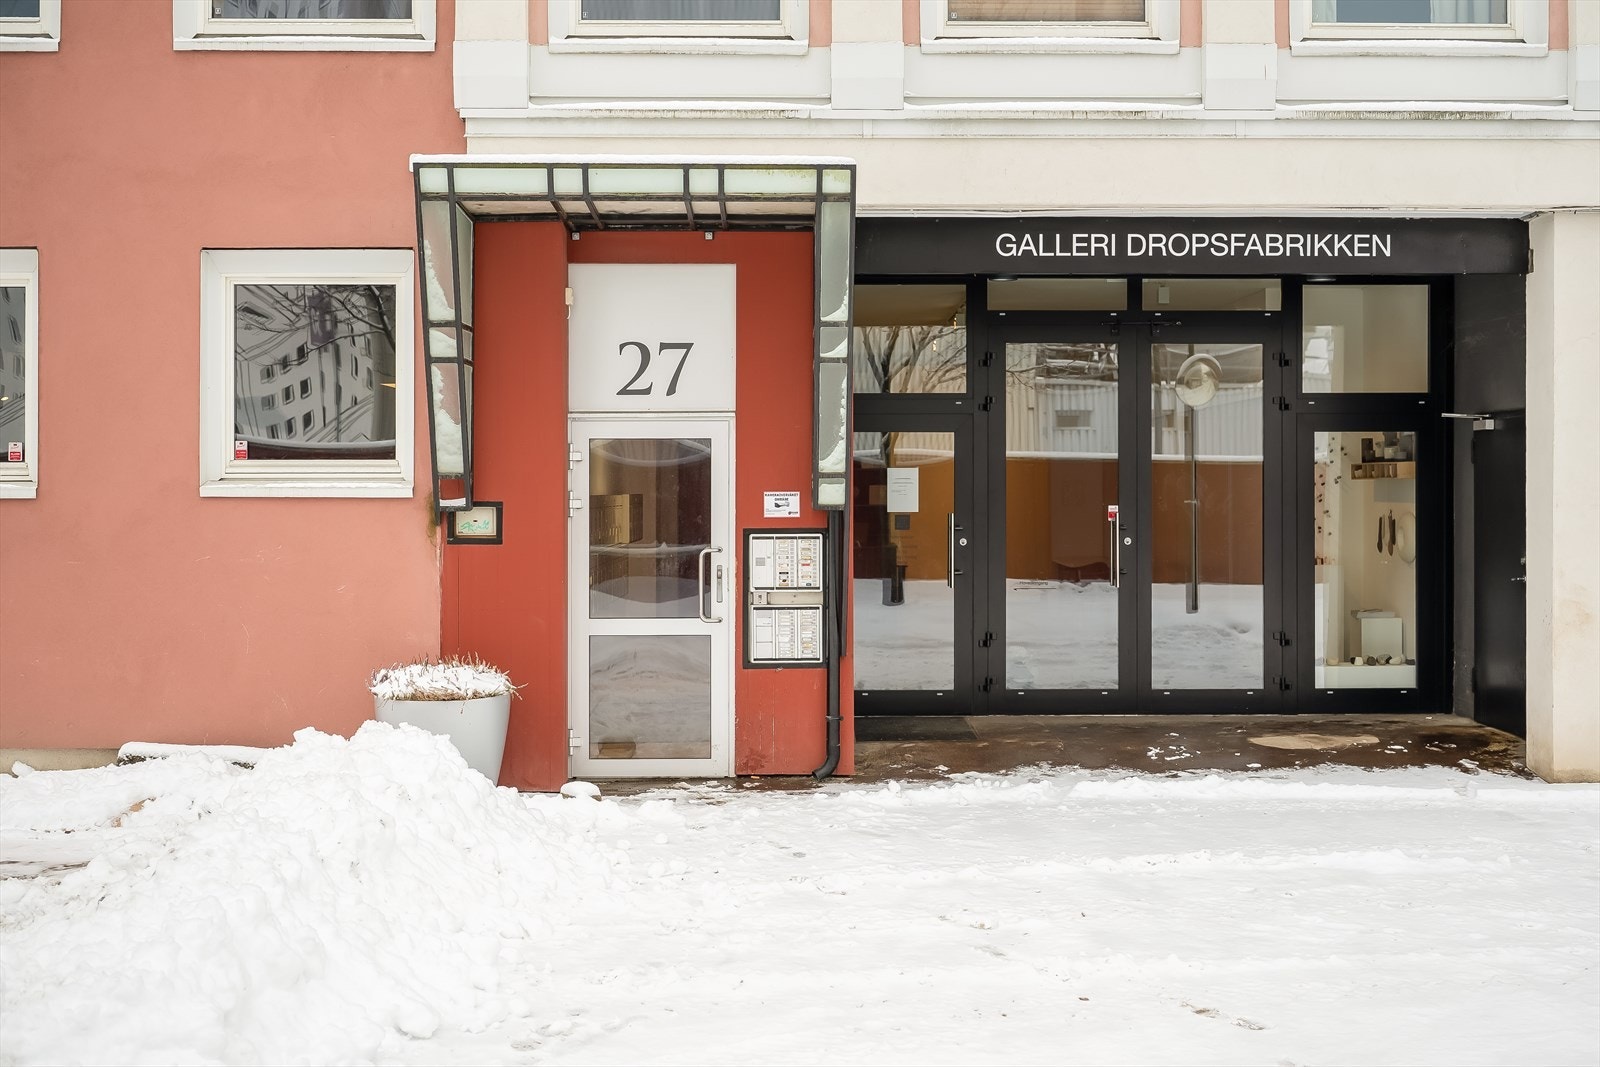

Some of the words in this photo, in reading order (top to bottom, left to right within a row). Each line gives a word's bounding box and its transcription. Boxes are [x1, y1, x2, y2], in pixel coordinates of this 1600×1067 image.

[995, 232, 1116, 258] GALLERI
[1127, 232, 1392, 258] DROPSFABRIKKEN
[615, 341, 695, 397] 27
